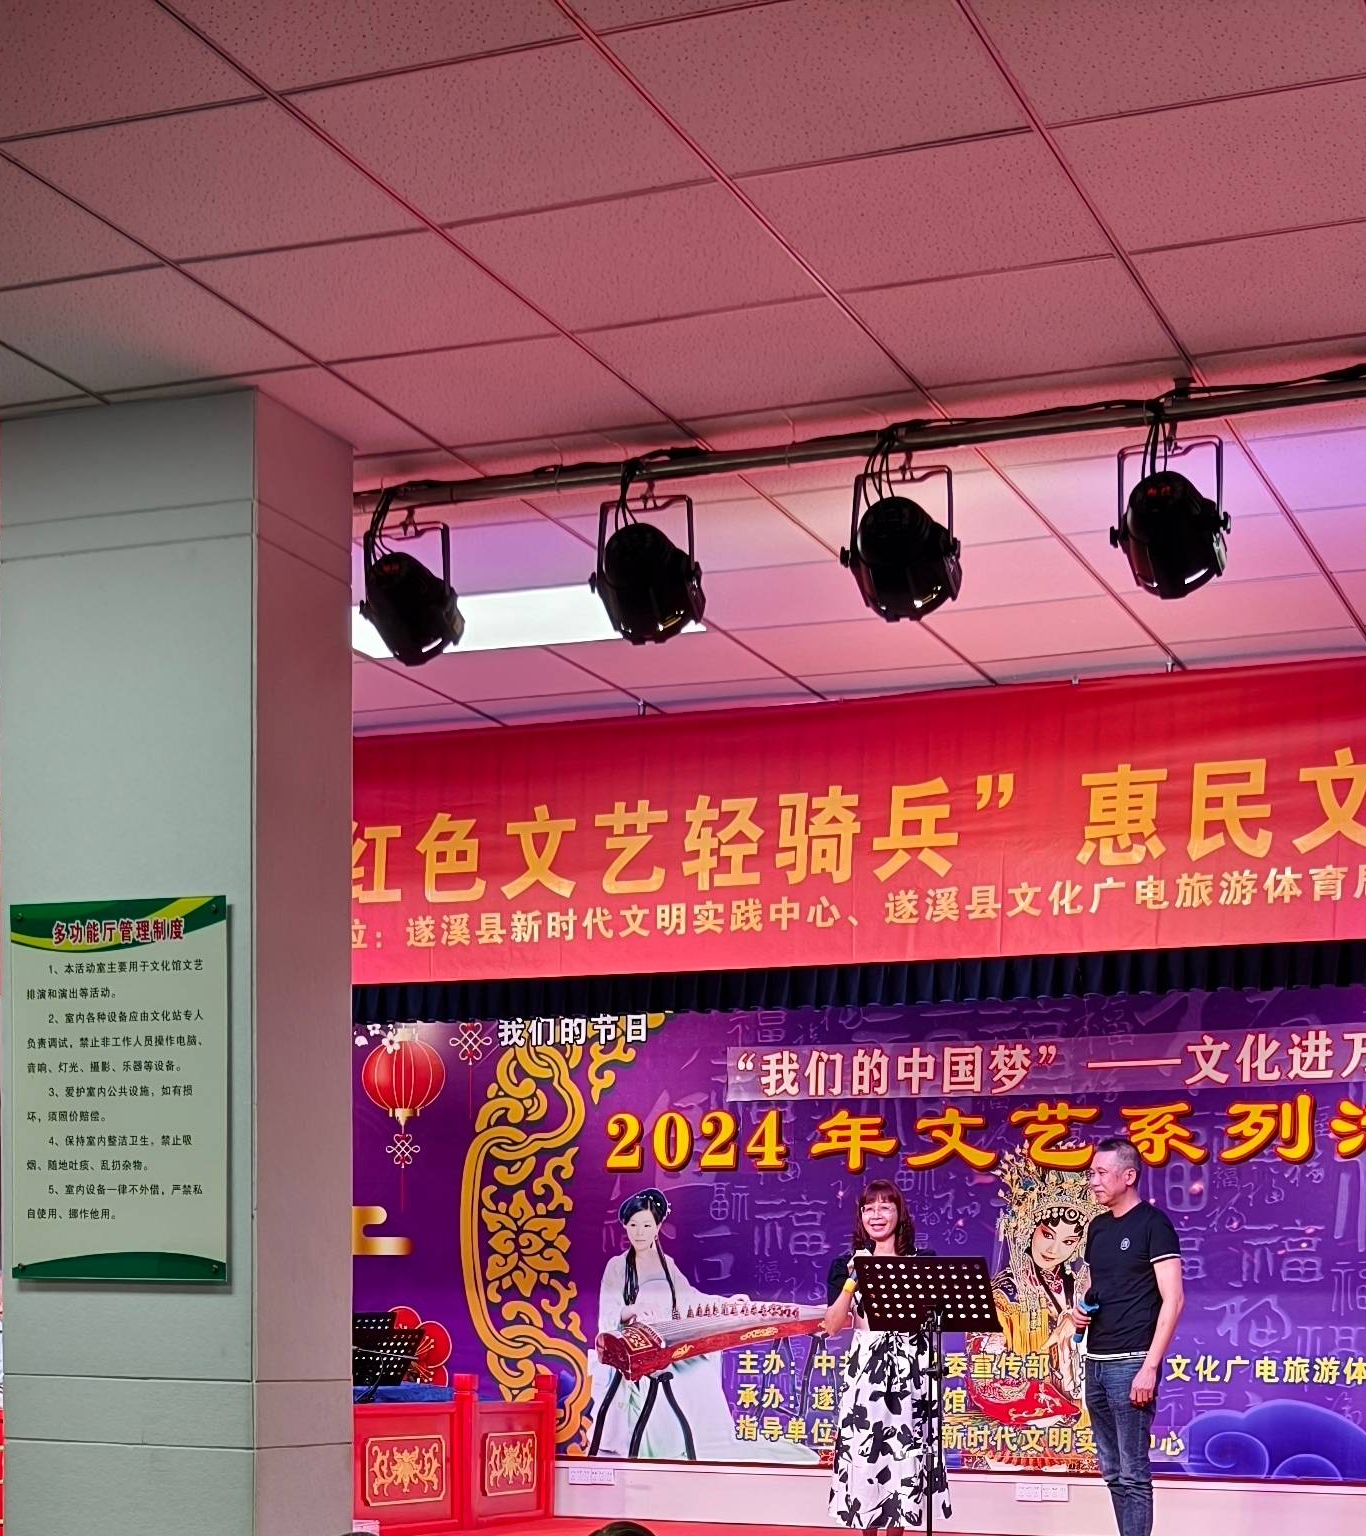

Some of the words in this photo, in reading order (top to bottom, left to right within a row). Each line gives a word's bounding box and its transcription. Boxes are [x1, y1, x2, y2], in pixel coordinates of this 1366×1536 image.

[52, 917, 184, 945] 多功能厅管理制度
[48, 959, 203, 974] 1、本活动室主要用于文化馆文艺
[27, 987, 116, 1000] 排演和演出等活动。
[48, 1009, 203, 1024] 2、室内各种设备应由文化站专人
[497, 1013, 648, 1047] 我们的节日
[48, 1184, 203, 1196] 5、室内设备一律不外借，严禁私
[27, 1208, 116, 1220] 自使用、挪作他用。
[943, 1351, 1085, 1380] 委宣传部、
[943, 1386, 967, 1413] 馆
[1151, 1430, 1185, 1456] 心
